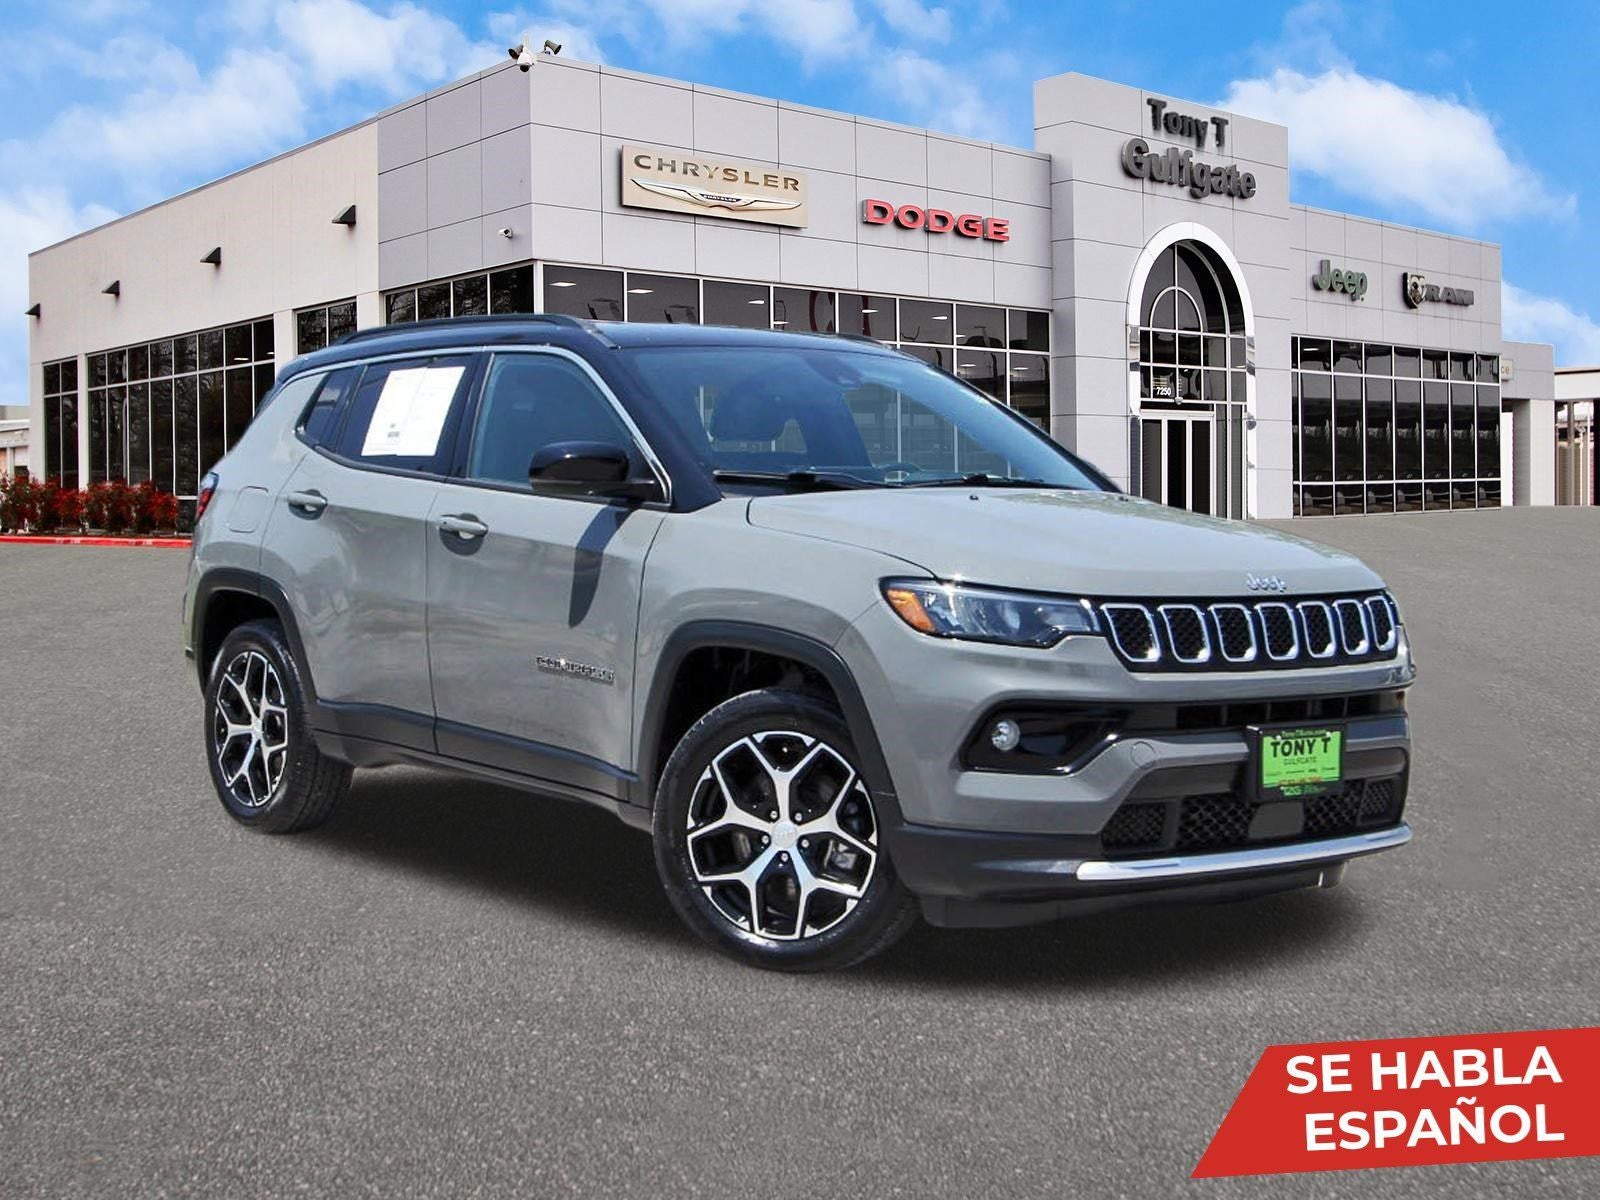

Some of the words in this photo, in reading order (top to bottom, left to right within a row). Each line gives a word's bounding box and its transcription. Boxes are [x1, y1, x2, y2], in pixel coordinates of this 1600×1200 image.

[1146, 97, 1208, 147] Tony
[1211, 116, 1229, 147] T
[633, 154, 800, 191] CHRYSLER
[1121, 137, 1257, 199] Gulfgate
[862, 198, 1011, 242] DODGE
[1312, 259, 1368, 302] Jeep
[1424, 284, 1475, 306] RAM
[1156, 386, 1172, 396] 7250
[1270, 739, 1317, 758] TONY
[1321, 737, 1331, 754] T
